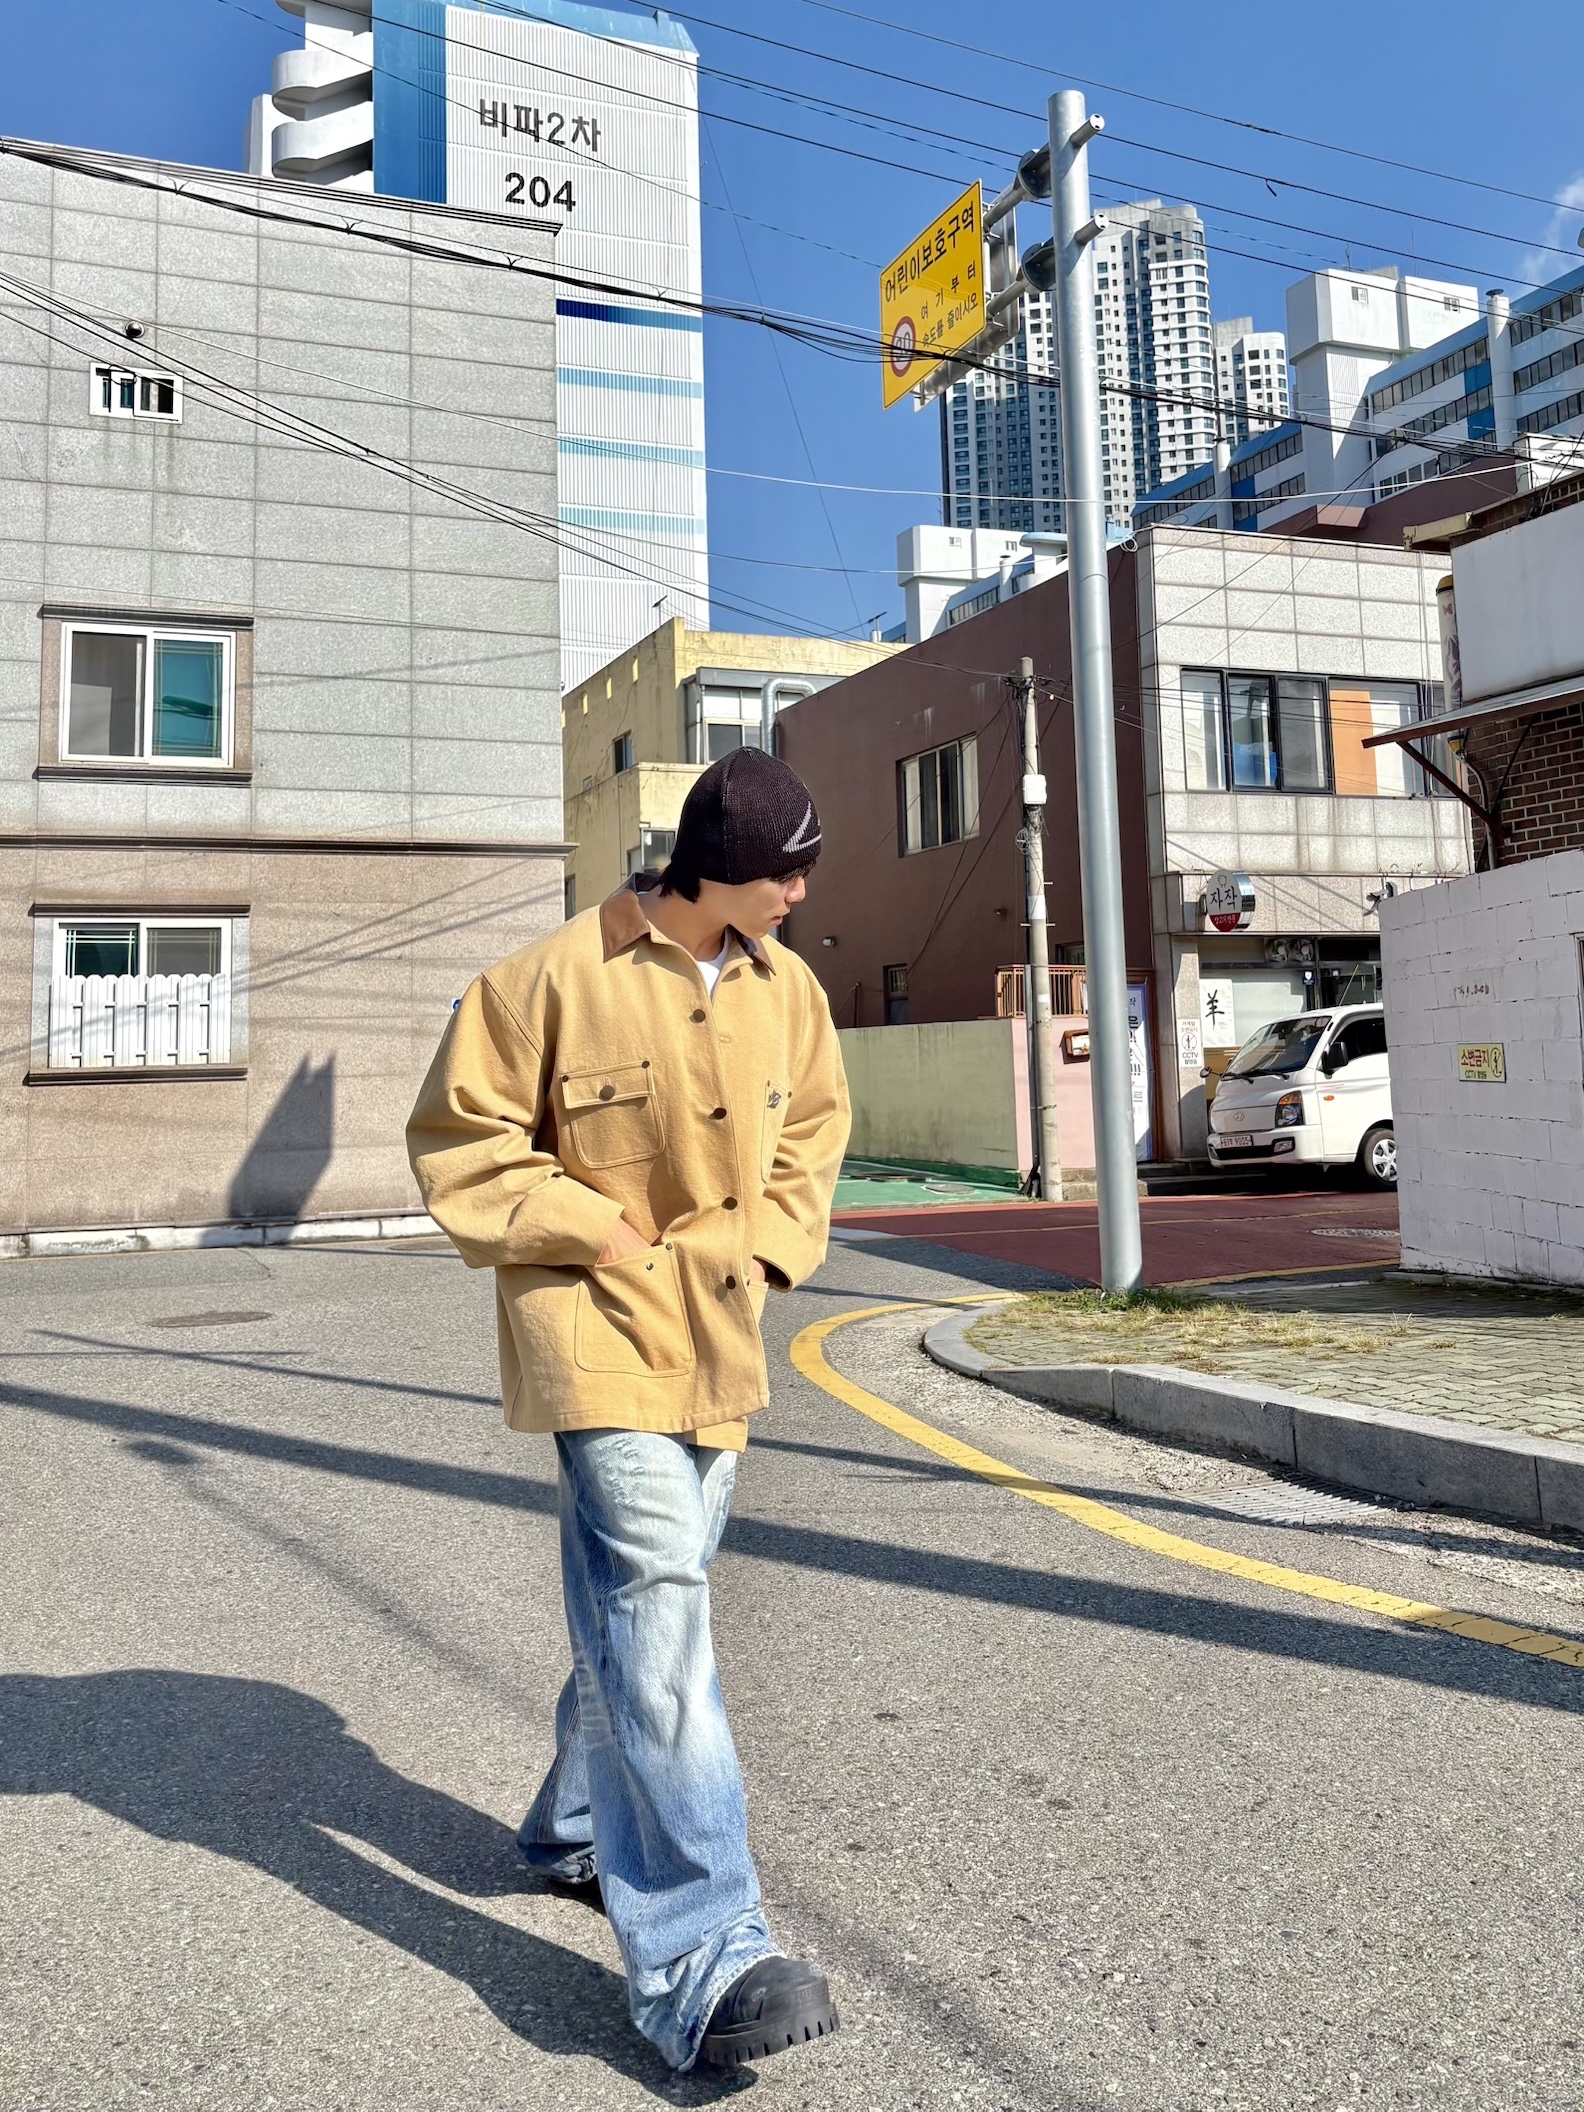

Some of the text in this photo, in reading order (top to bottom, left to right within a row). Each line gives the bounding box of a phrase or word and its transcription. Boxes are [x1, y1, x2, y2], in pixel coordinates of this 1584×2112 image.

[479, 98, 602, 152] 비파2차
[505, 172, 576, 212] 204
[885, 200, 975, 303] 어린이보호구역
[922, 292, 979, 348] 속도를 줄이시오
[1210, 885, 1238, 911] 자작
[1205, 989, 1225, 1031] 羊
[1461, 1049, 1490, 1068] 소변금지
